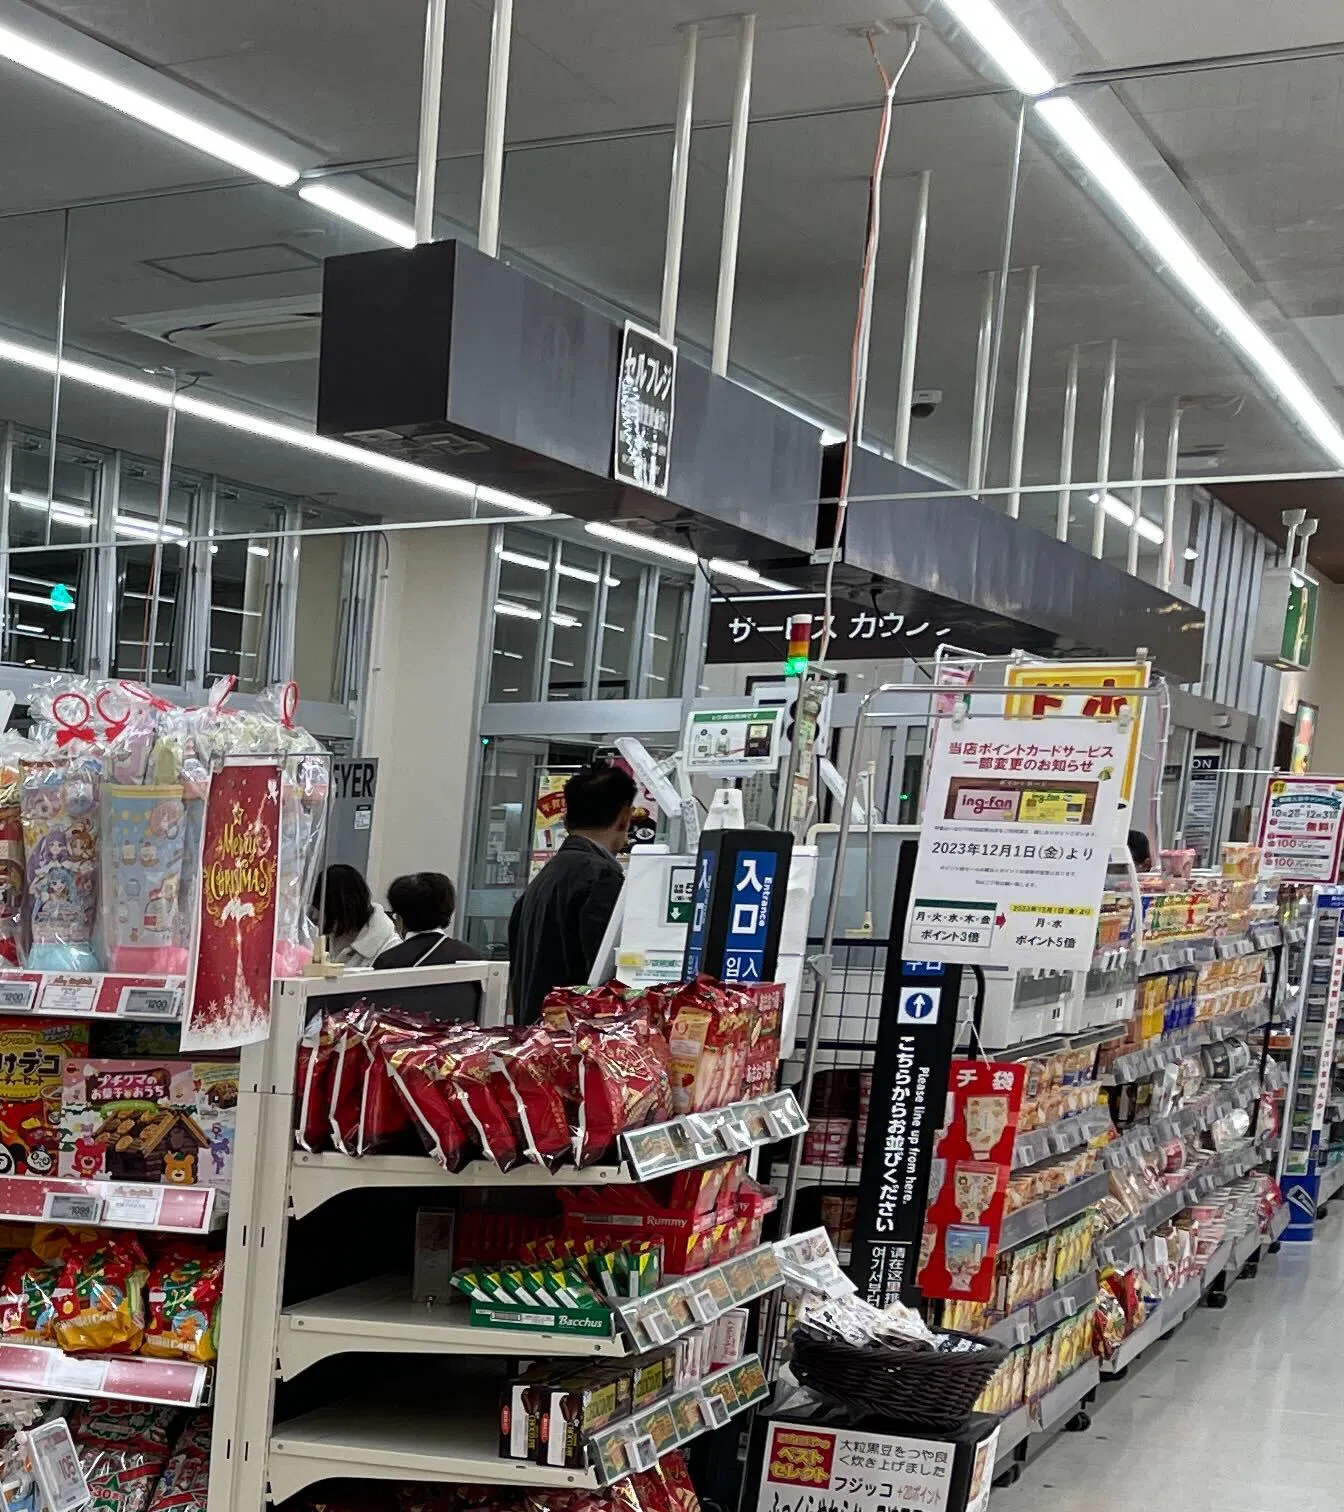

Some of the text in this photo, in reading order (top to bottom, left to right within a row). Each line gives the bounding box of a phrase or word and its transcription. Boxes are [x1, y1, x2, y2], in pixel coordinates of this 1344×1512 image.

[948, 741, 1114, 759] 当店ポイントカードサービス
[963, 756, 1094, 773] 一部変更のお知らせ
[221, 822, 262, 858] Merry
[931, 841, 1095, 862] 2023年12月1日(金)より
[209, 858, 273, 900] CHRISTMAS
[730, 858, 763, 935] 入口
[758, 876, 773, 927] Entrance
[915, 910, 991, 926] 月・火・水・木・金
[1034, 917, 1063, 929] 月・水
[919, 929, 981, 944] ポイント3倍
[1015, 935, 1077, 949] ポイント5倍
[97, 1073, 158, 1088] プチクマの
[875, 1035, 916, 1233] こちらからお並びください
[902, 1066, 931, 1205] Please line up from here.
[646, 1215, 688, 1228] Rummy
[558, 1315, 603, 1329] Bacchus
[839, 1439, 949, 1464] 大粒黒豆をつや良
[839, 1456, 947, 1478] く炊き上げました
[833, 1476, 893, 1499] フジッコ
